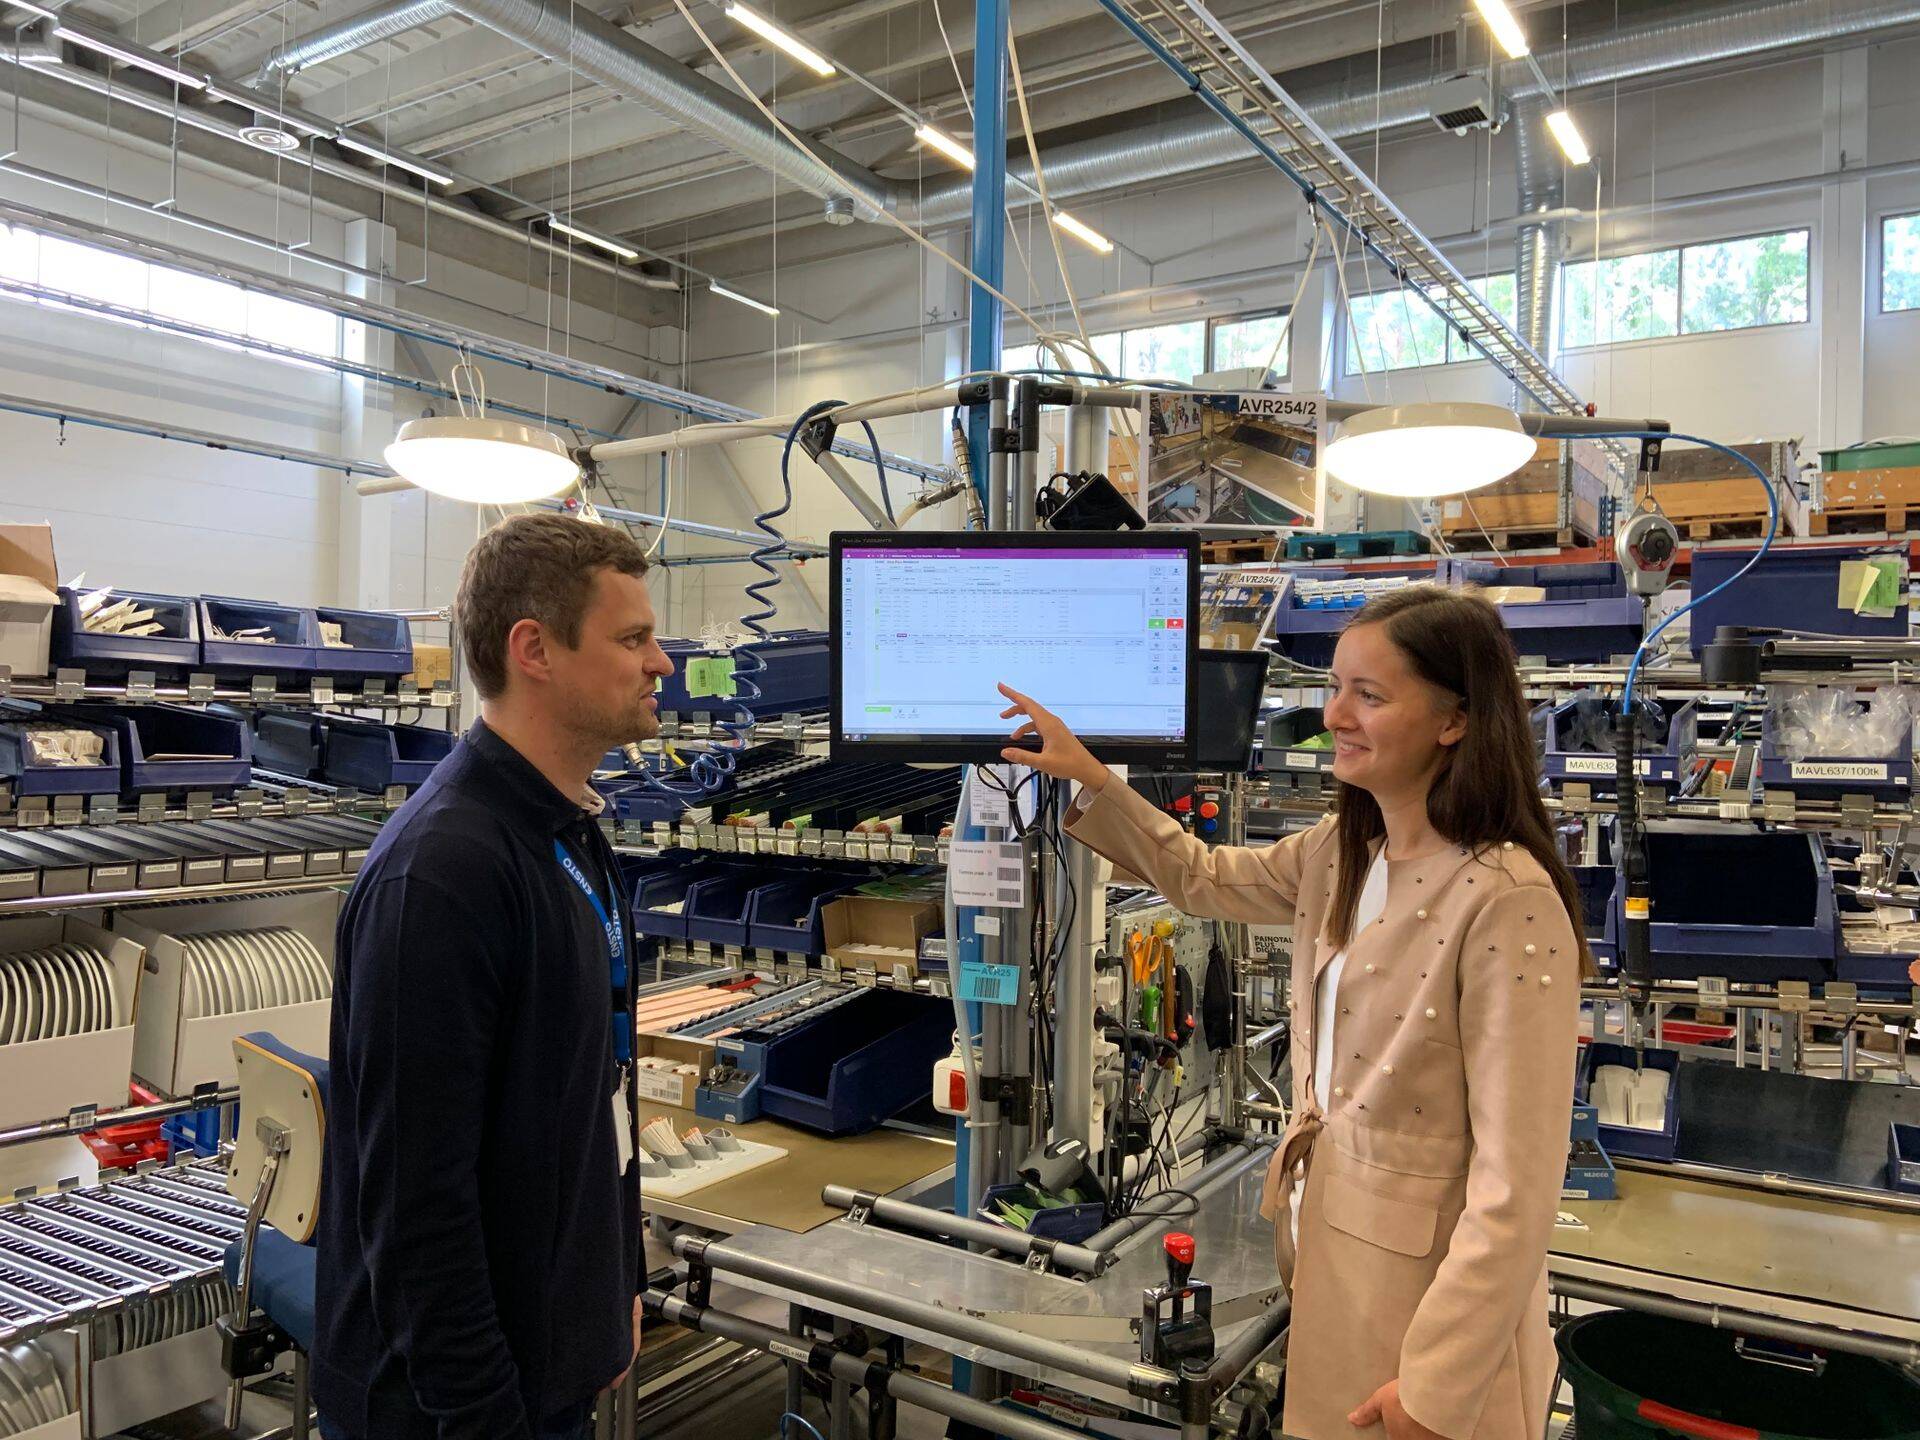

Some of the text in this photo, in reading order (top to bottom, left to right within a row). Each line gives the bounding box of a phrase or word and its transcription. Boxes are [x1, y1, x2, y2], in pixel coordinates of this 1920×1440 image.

[1239, 398, 1317, 415] AVR254/2
[1239, 575, 1285, 584] AVR254/1
[562, 857, 592, 895] ENSTO
[605, 922, 621, 958] ENSTO
